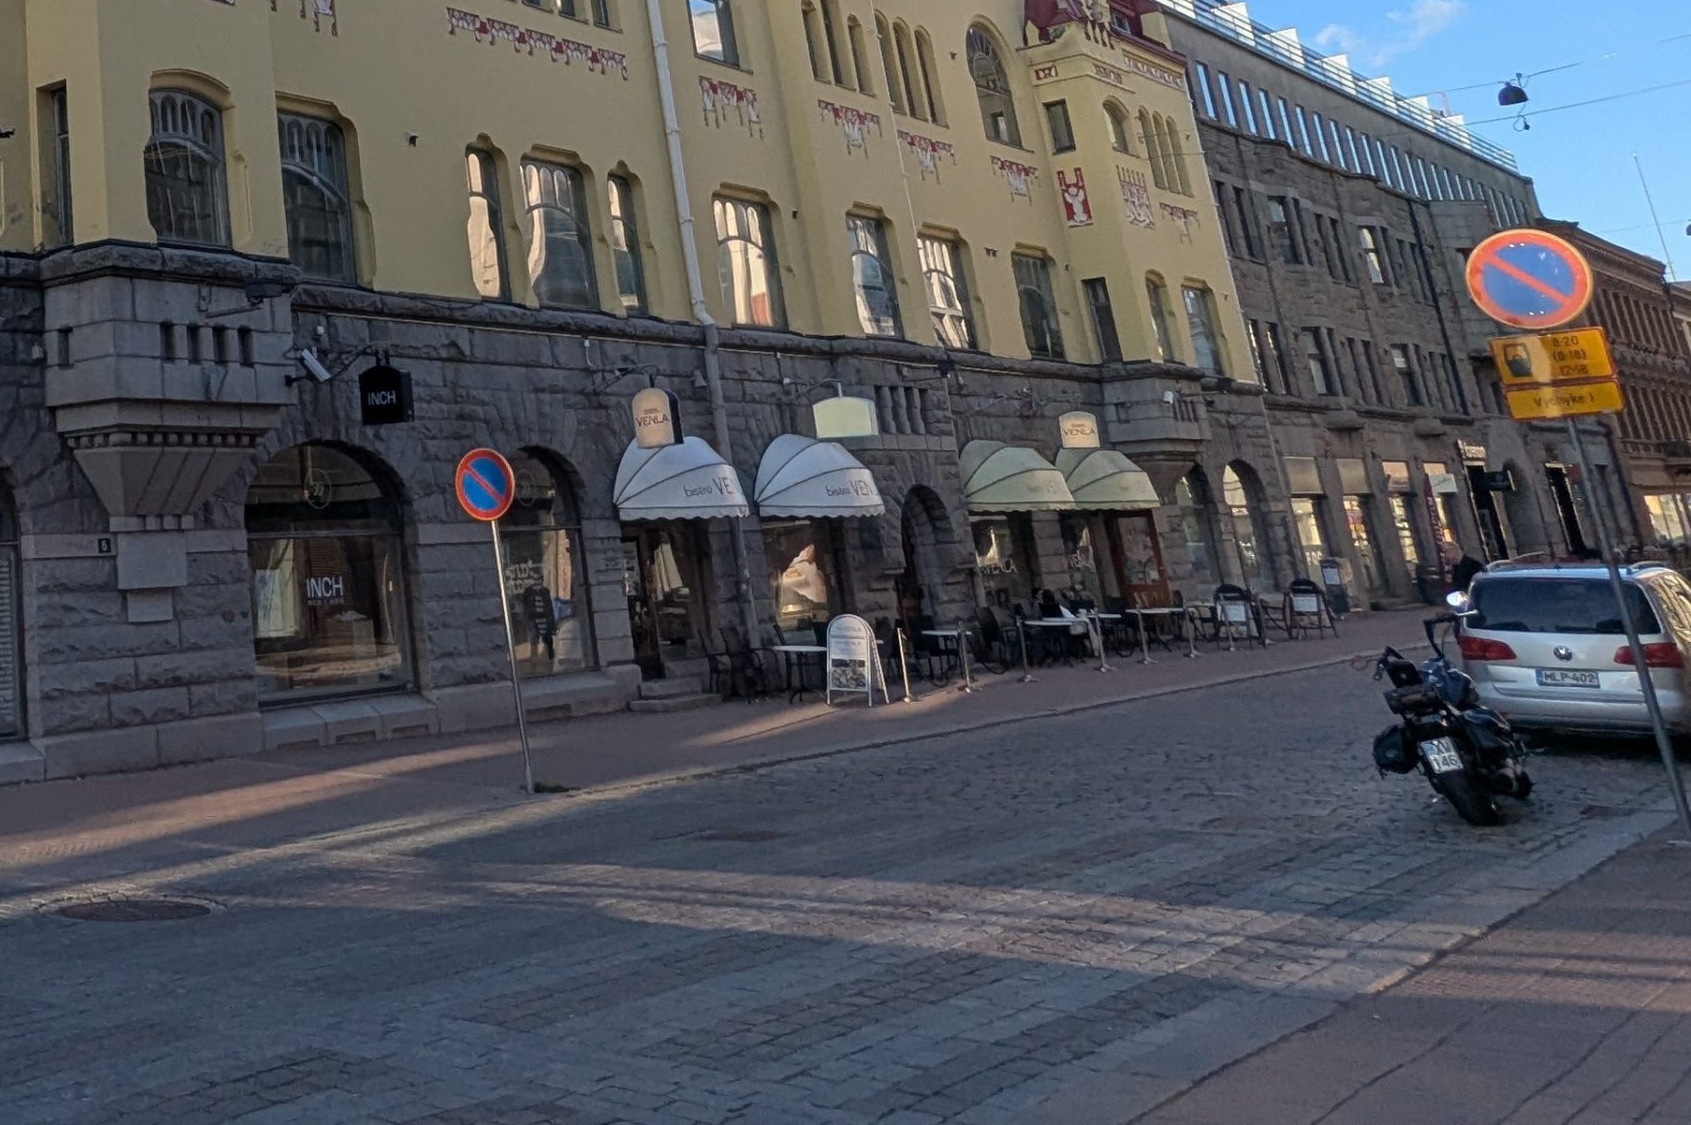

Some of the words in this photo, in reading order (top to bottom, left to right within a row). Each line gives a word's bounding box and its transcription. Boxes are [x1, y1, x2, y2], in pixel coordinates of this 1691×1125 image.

[367, 390, 398, 407] INCH
[635, 413, 670, 428] VENLA
[306, 576, 345, 598] INCH
